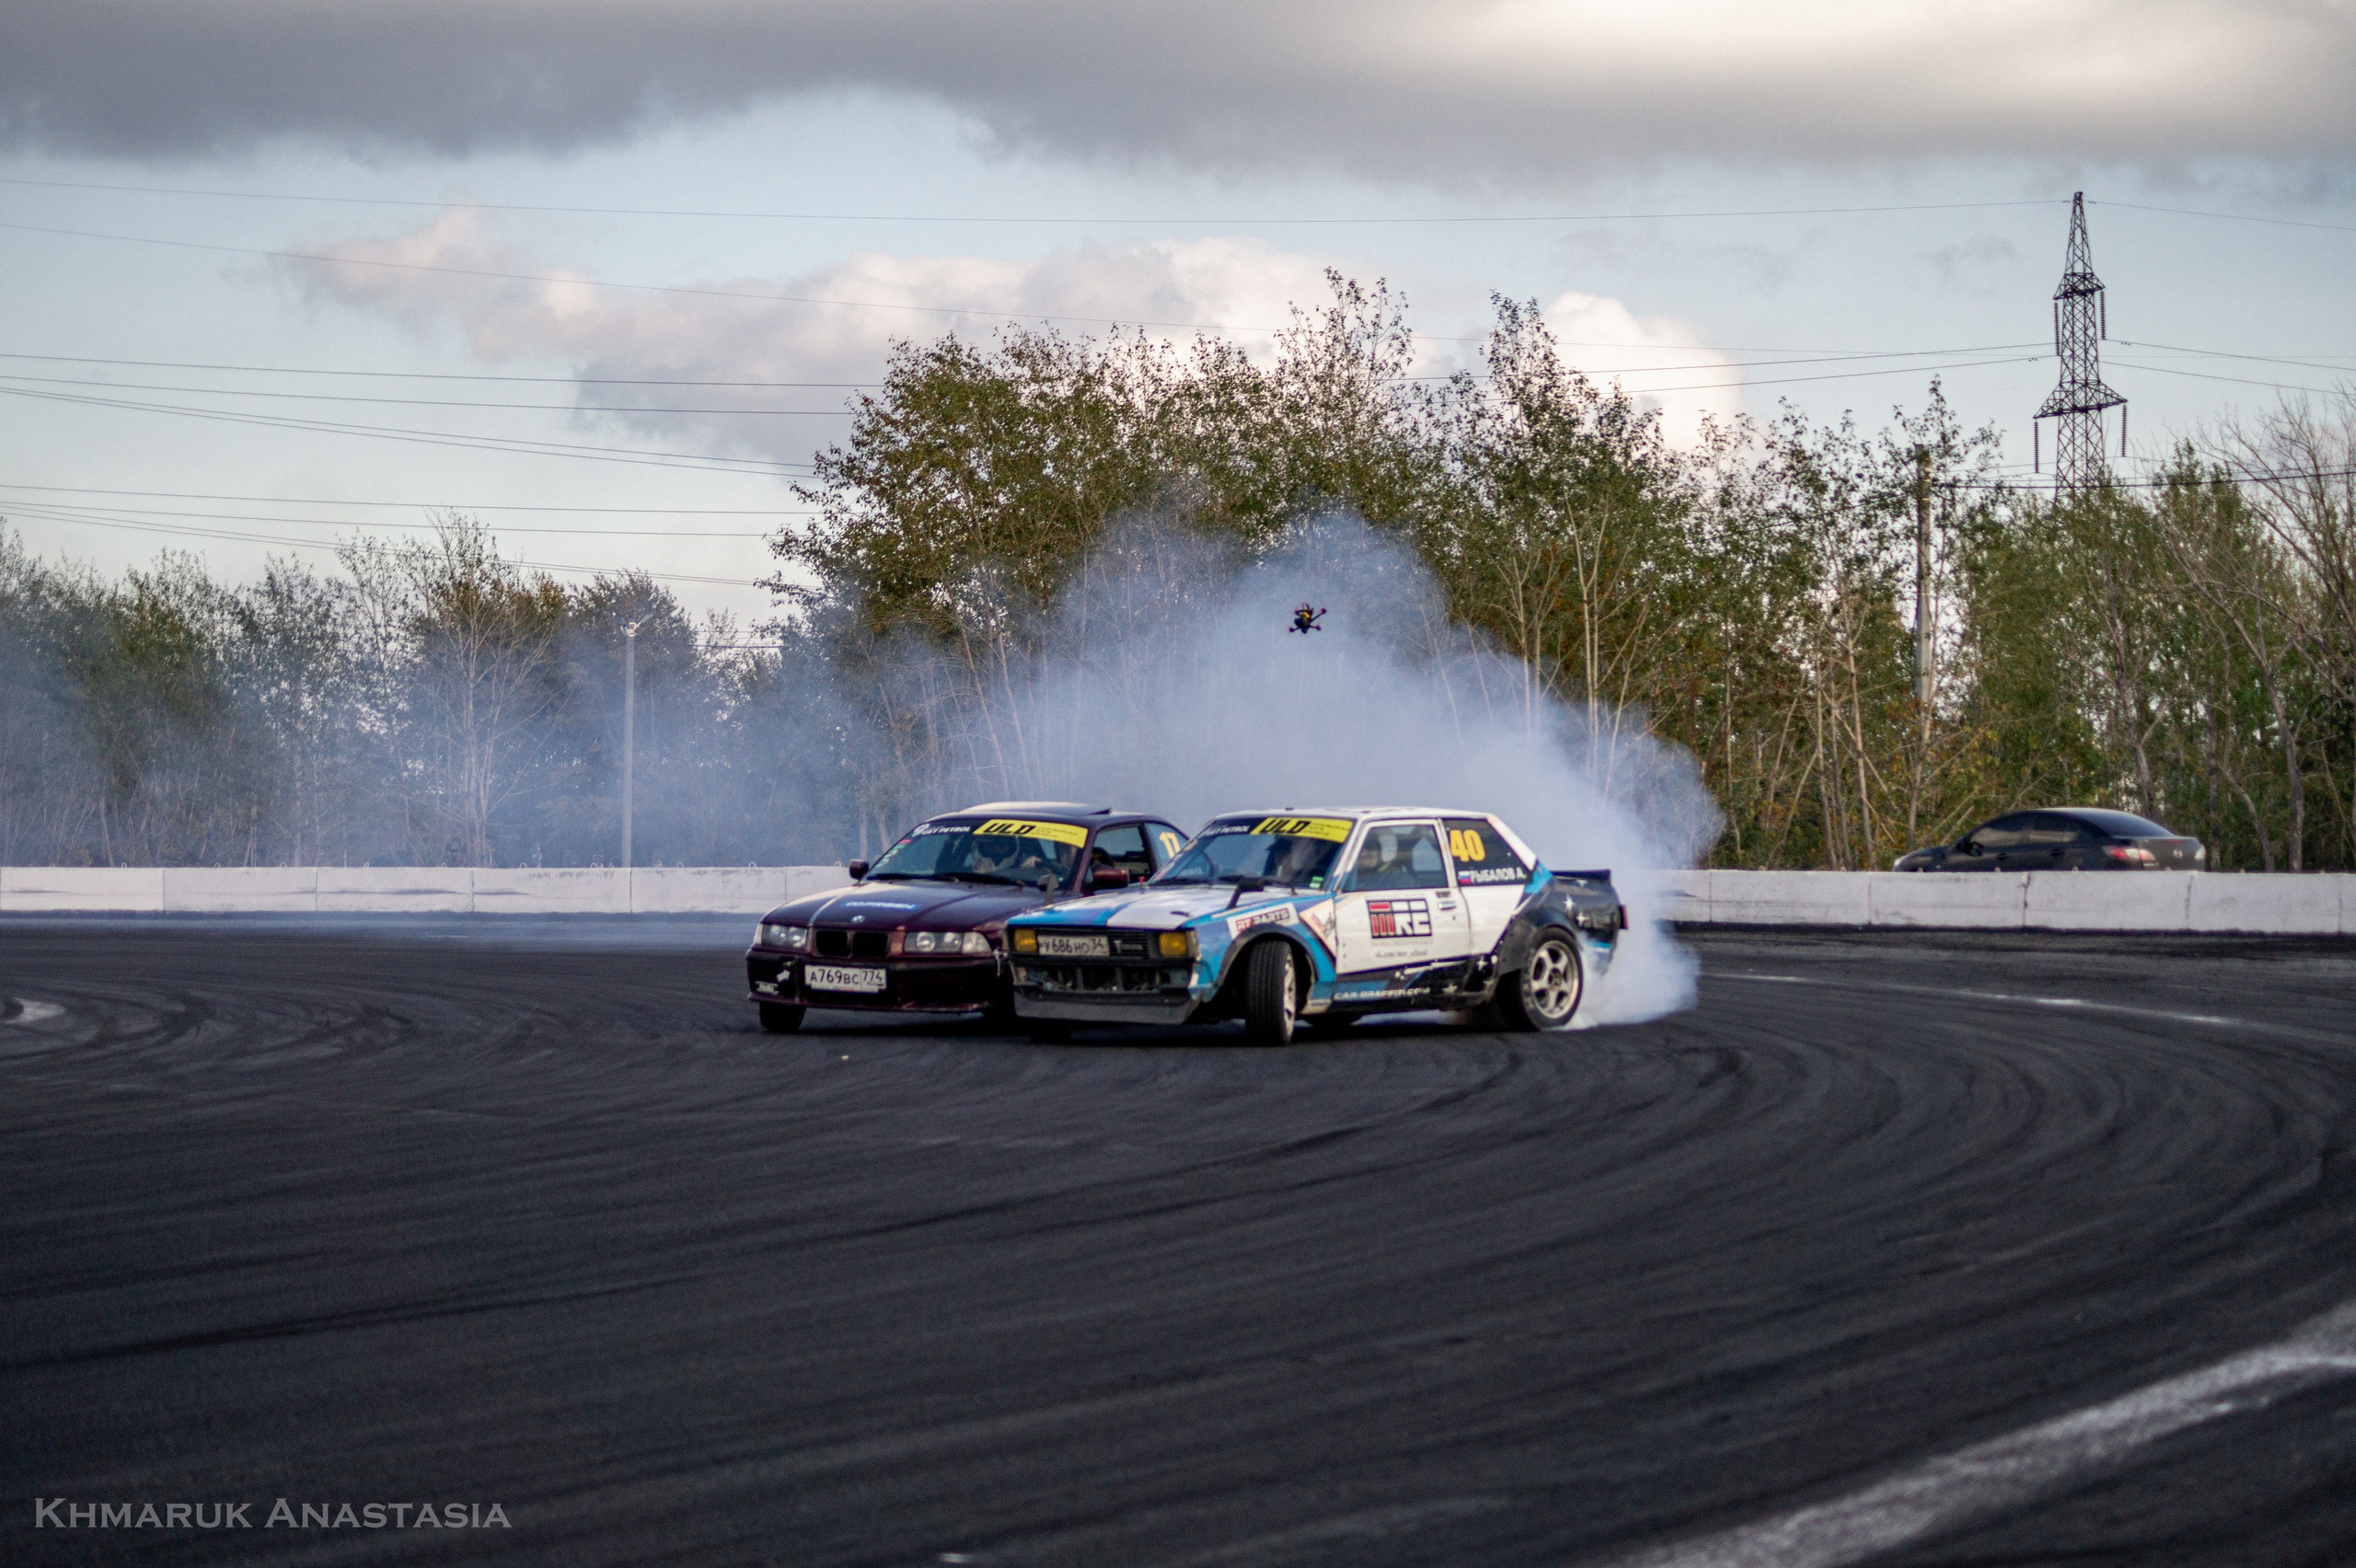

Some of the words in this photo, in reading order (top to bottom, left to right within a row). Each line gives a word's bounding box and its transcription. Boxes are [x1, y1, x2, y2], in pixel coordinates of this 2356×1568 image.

[983, 822, 1037, 836] ULD
[1259, 819, 1311, 834] ULD
[1449, 829, 1486, 862] 40
